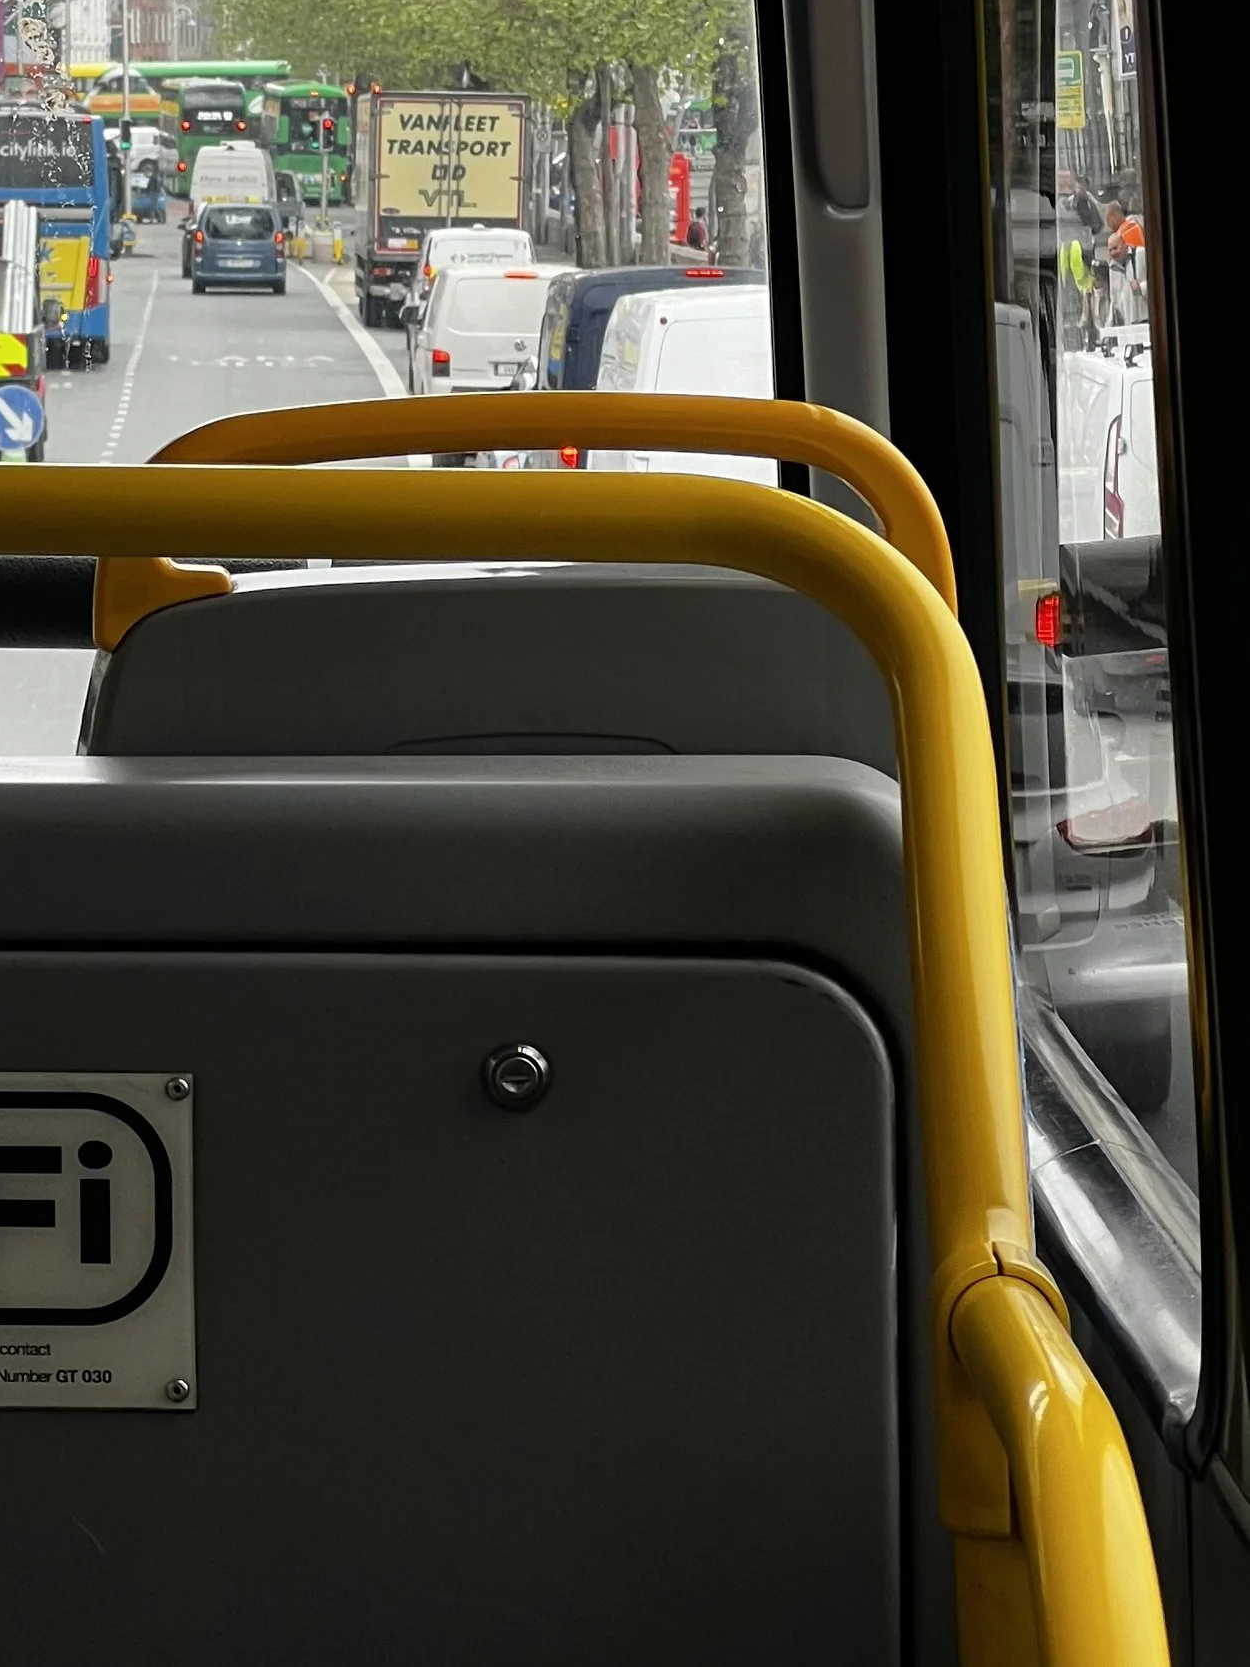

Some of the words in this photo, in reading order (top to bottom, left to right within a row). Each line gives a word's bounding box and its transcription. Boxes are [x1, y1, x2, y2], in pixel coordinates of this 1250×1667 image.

[386, 138, 512, 157] TRANSPORT
[430, 163, 467, 182] LTD
[225, 214, 253, 225] Uber
[0, 1343, 52, 1357] contact
[55, 1369, 79, 1384] GT
[81, 1369, 113, 1384] 030
